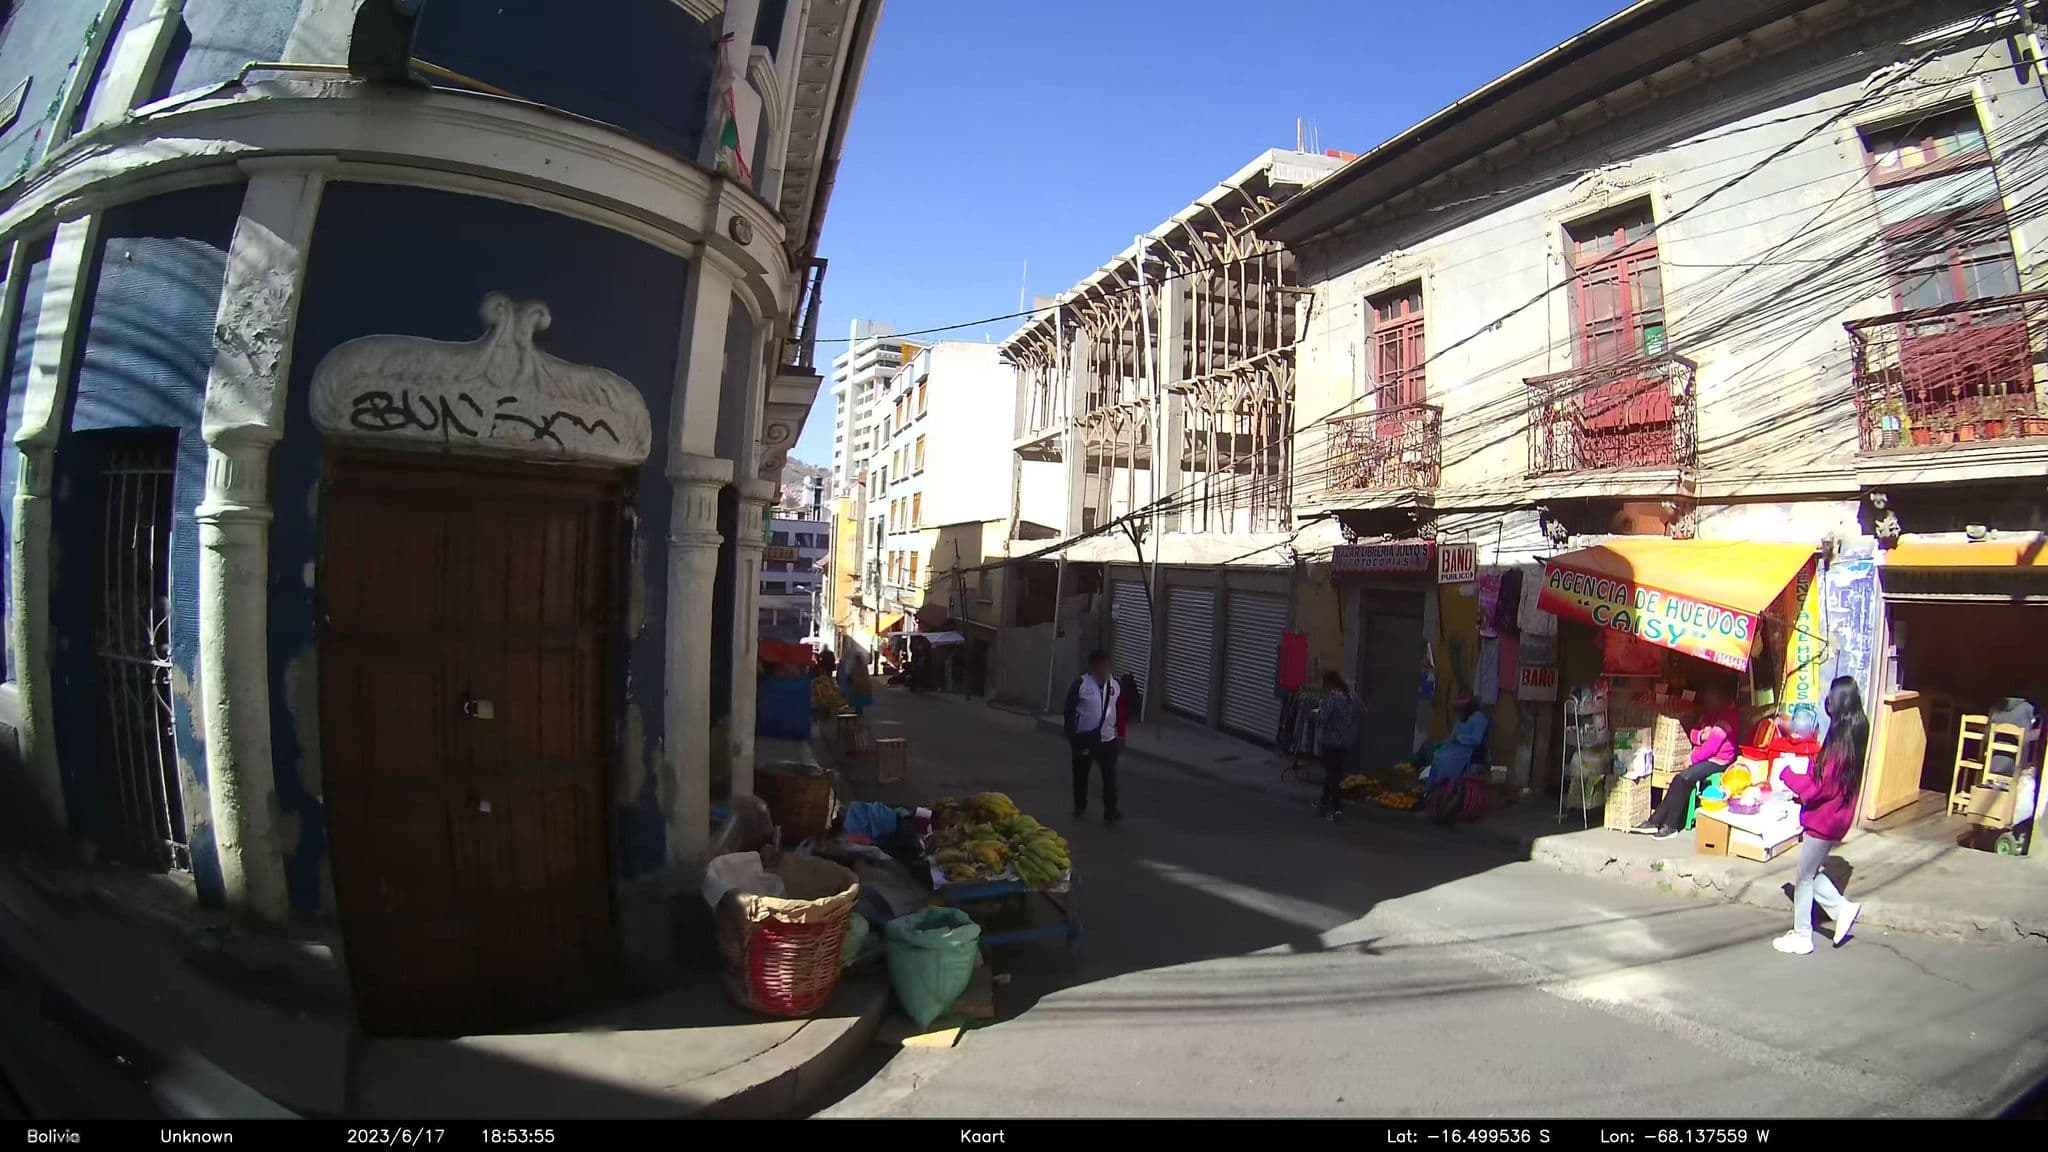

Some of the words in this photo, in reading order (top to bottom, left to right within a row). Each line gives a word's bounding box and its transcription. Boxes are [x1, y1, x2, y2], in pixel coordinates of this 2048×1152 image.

[1550, 570, 1627, 605] AGENCIA
[1635, 590, 1659, 613] DE
[1666, 599, 1748, 639] HUEVOS
